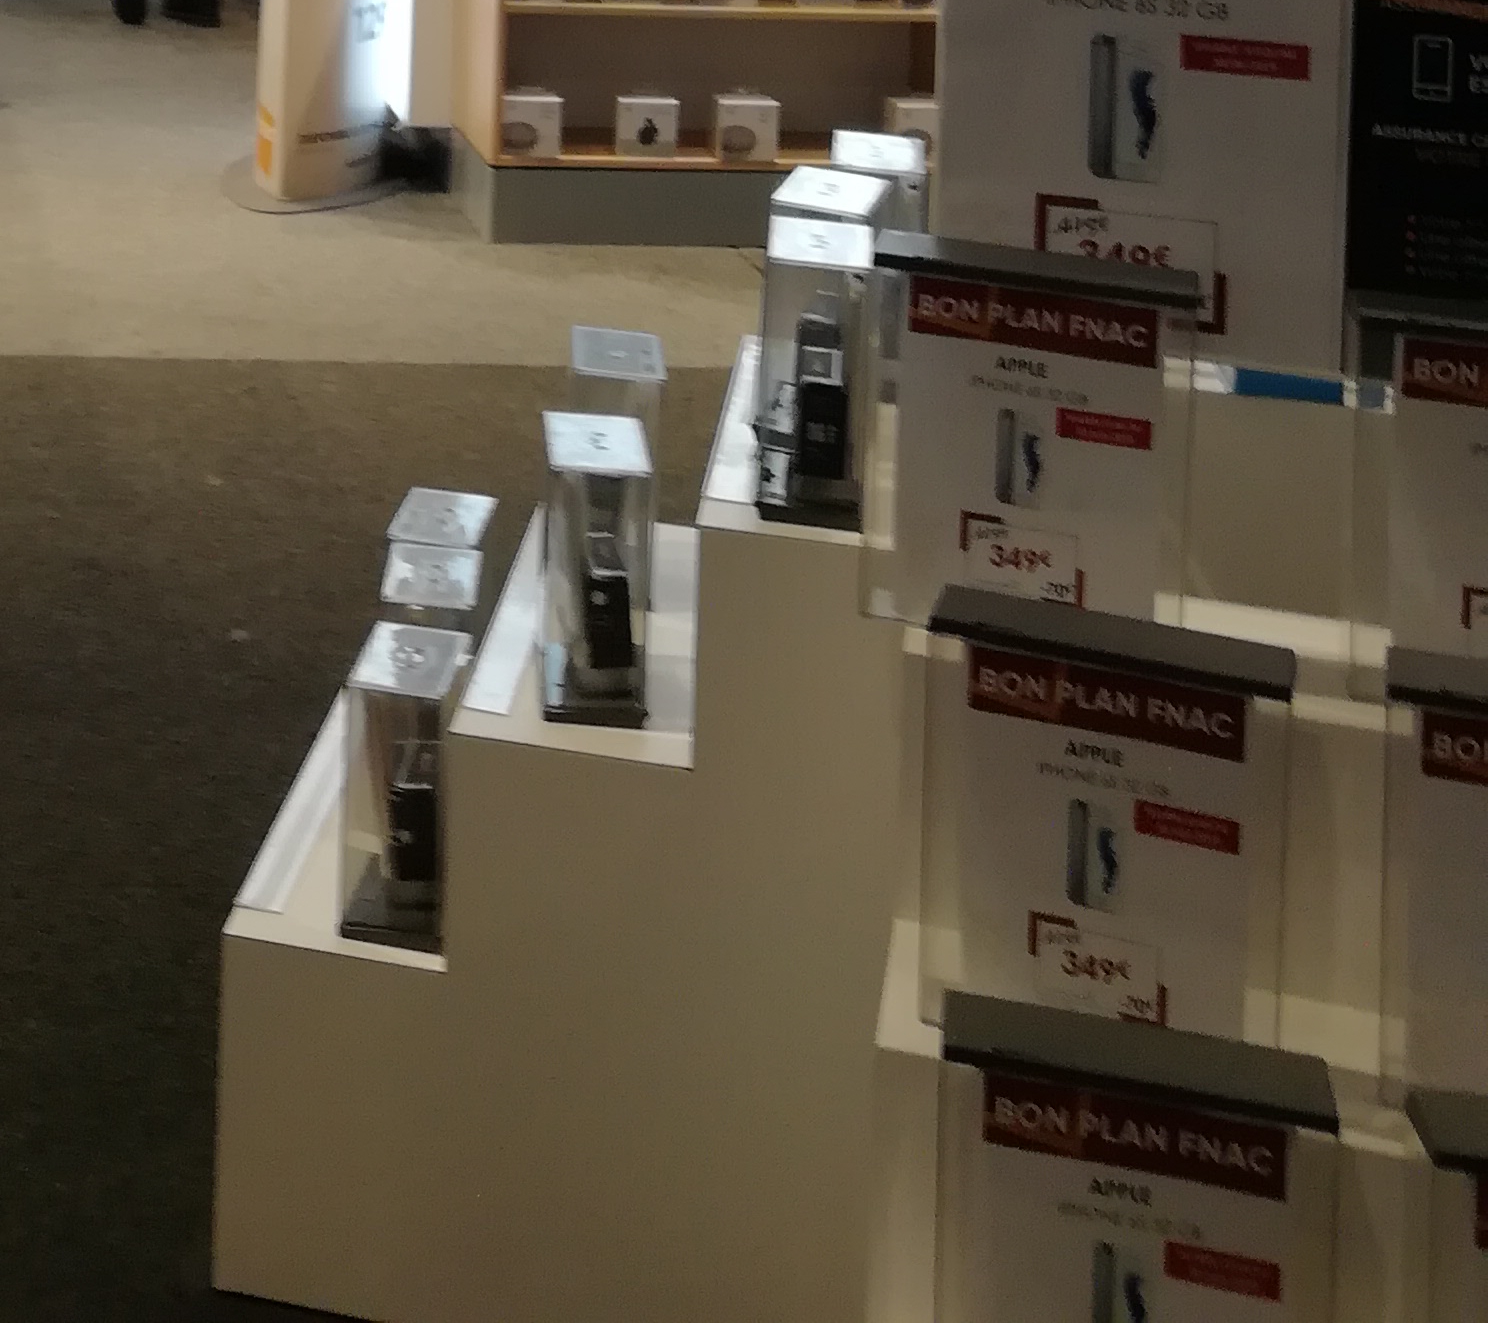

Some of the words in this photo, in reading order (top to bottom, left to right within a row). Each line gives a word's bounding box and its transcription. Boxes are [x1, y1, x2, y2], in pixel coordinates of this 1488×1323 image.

[916, 292, 980, 323] BON
[987, 302, 1061, 335] PLAN
[1068, 314, 1149, 349] FNAC
[1412, 356, 1480, 388] BON
[977, 664, 1049, 702] BON
[1054, 678, 1140, 719] PLAN
[1146, 694, 1236, 740] FNAC
[992, 1094, 1069, 1135] BON
[1076, 1106, 1170, 1154] PLAN
[1177, 1125, 1274, 1177] FNAC
